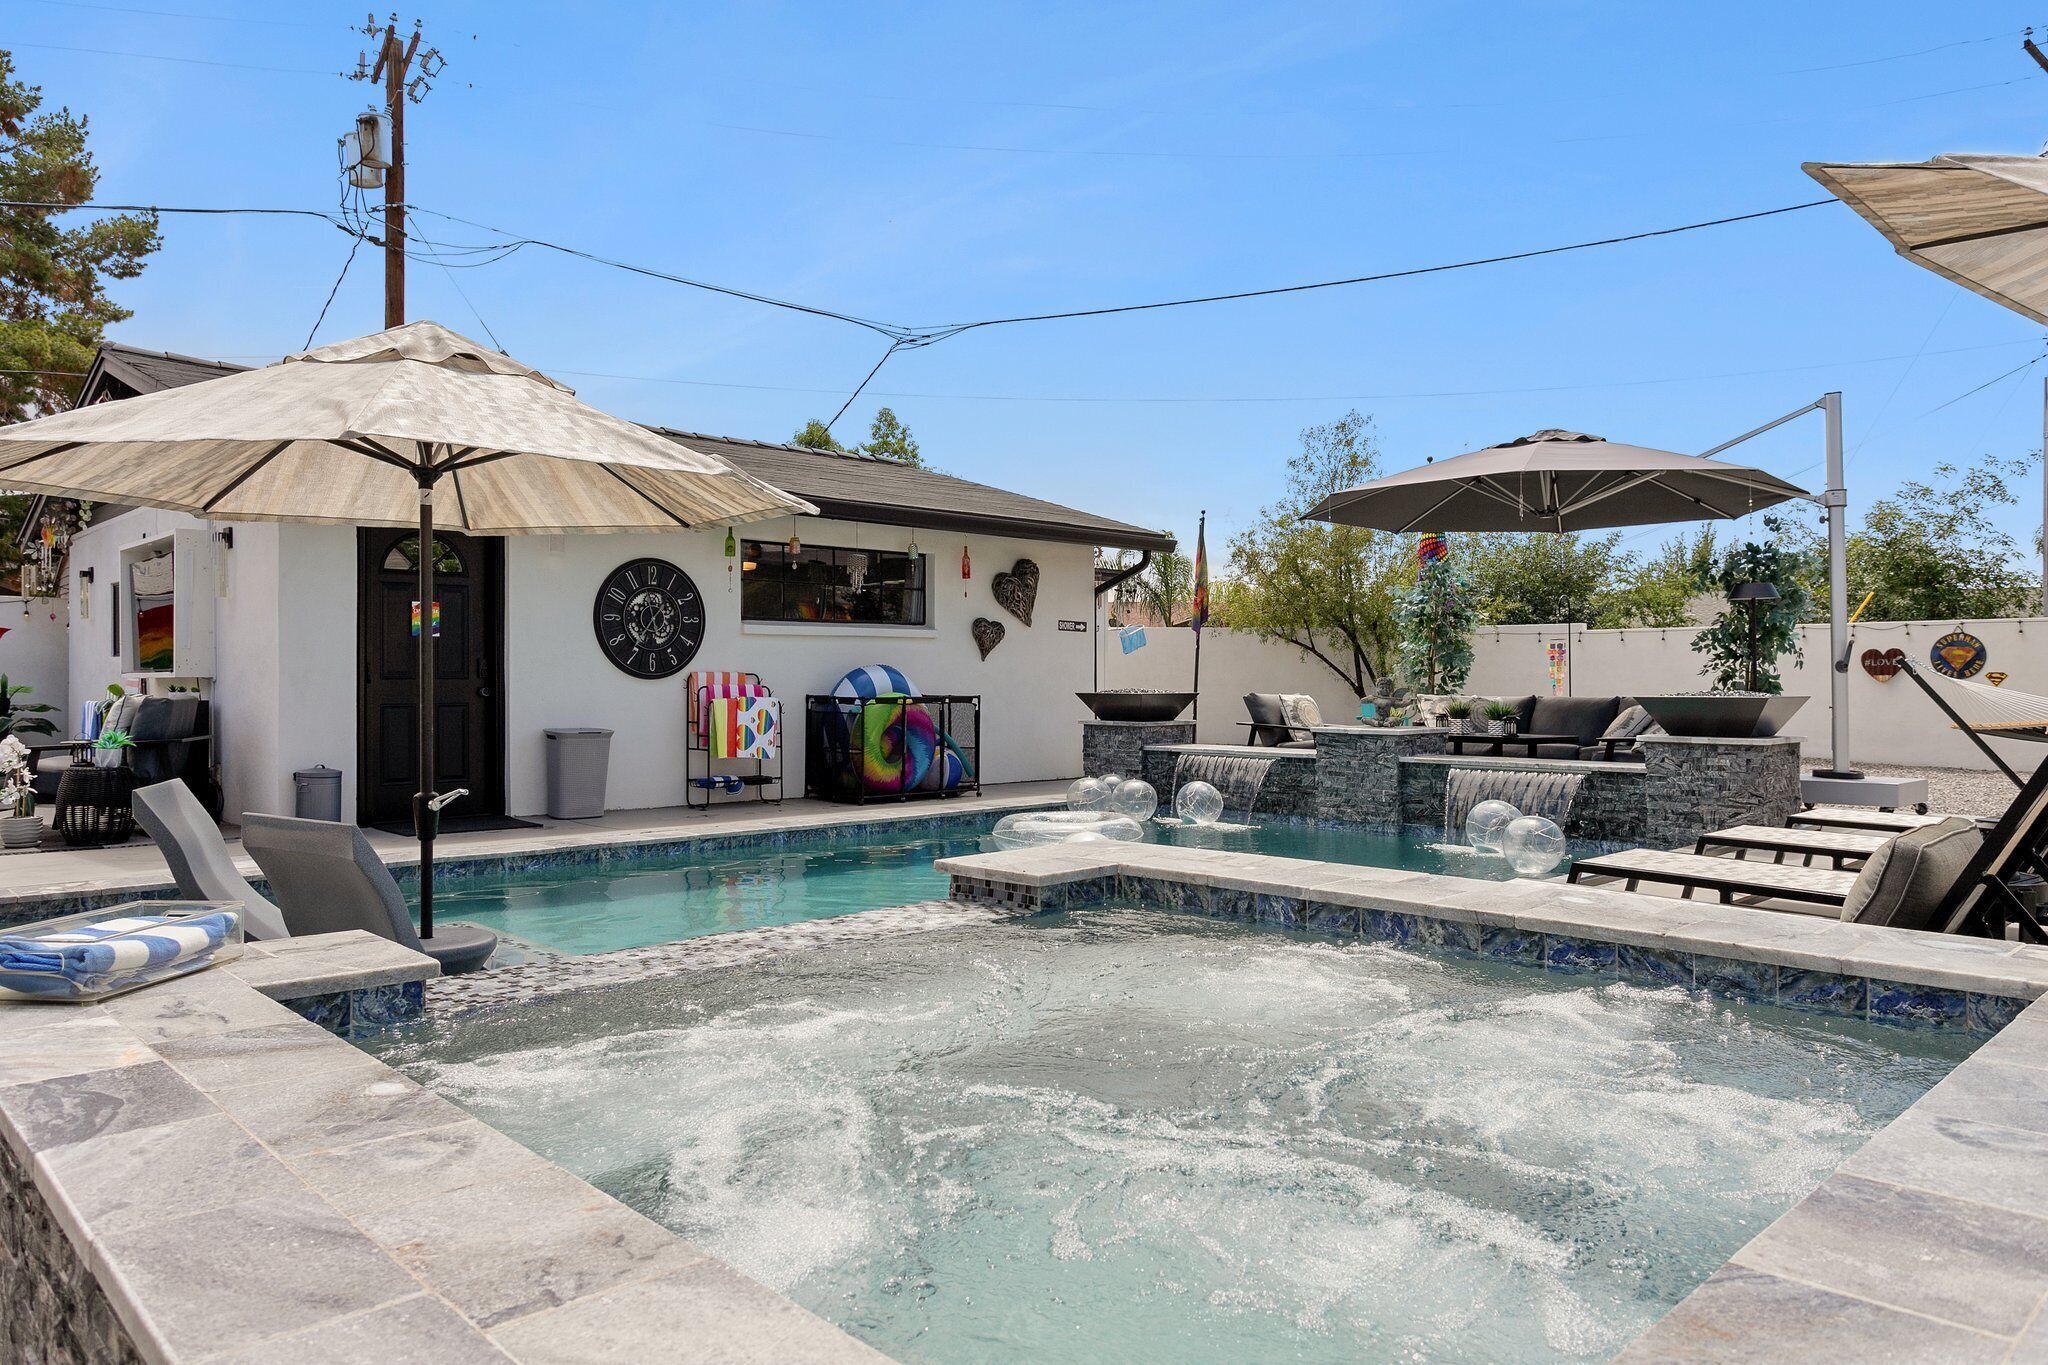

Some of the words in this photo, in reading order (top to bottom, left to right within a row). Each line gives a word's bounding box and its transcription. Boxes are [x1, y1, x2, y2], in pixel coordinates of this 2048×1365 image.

[625, 570, 639, 590] 11
[648, 566, 657, 585] 12
[667, 574, 676, 590] 1
[607, 587, 627, 605] 10
[678, 592, 694, 606] 2
[603, 613, 621, 621] 9
[1059, 621, 1075, 630] SHOWER
[609, 633, 626, 646] 8
[680, 634, 694, 646] 4
[1936, 633, 1981, 649] SUPERMAN
[627, 646, 639, 664] 7
[649, 653, 656, 672] 6
[667, 647, 678, 666] 5
[1963, 659, 1985, 678] HERE
